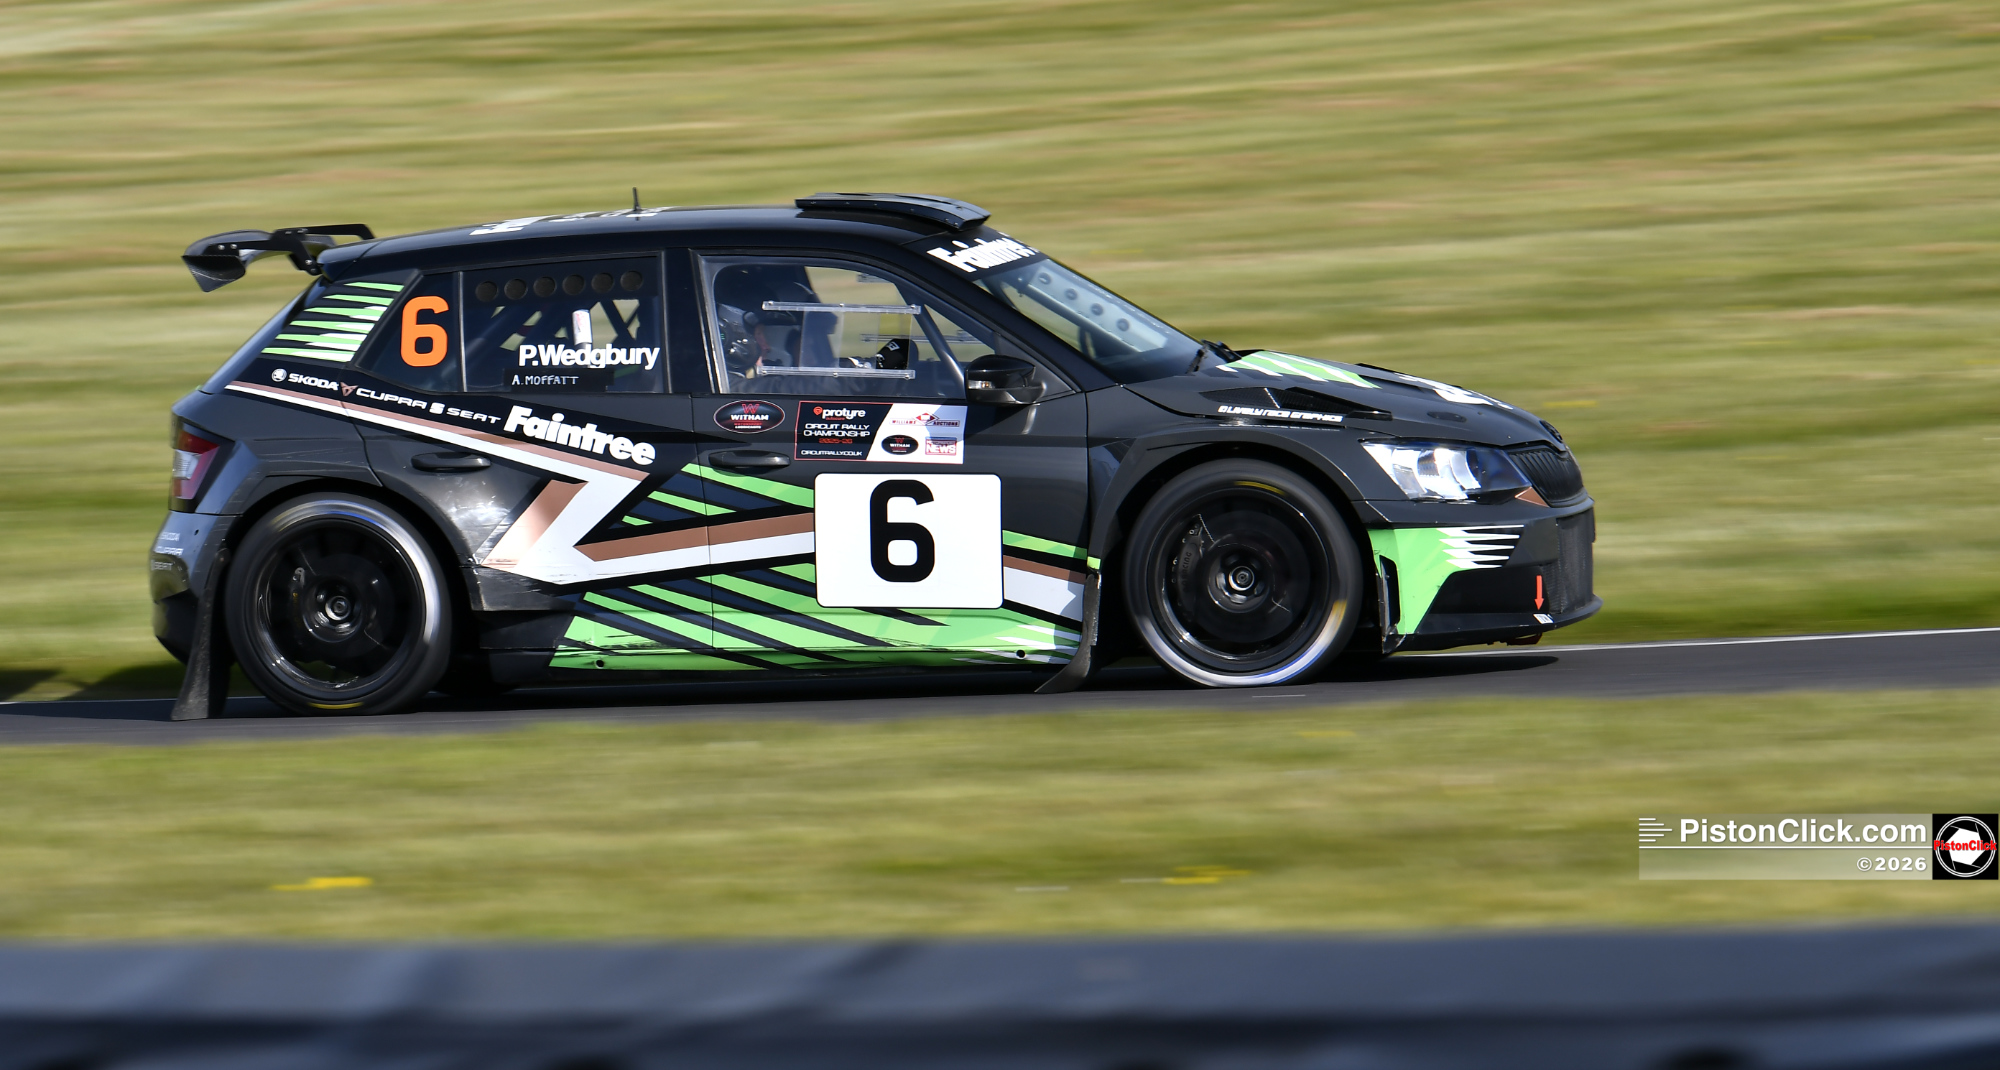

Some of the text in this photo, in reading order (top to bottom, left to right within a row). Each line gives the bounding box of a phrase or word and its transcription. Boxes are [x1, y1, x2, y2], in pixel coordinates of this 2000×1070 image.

[400, 295, 450, 368] 6
[518, 343, 661, 371] P.Wedgbury
[287, 373, 340, 391] SKODA
[355, 387, 428, 410] CUPRA
[446, 407, 502, 425] SEAT
[821, 407, 866, 420] protyre
[503, 405, 656, 466] Faintree
[926, 443, 956, 454] NEWS
[869, 479, 936, 583] 6
